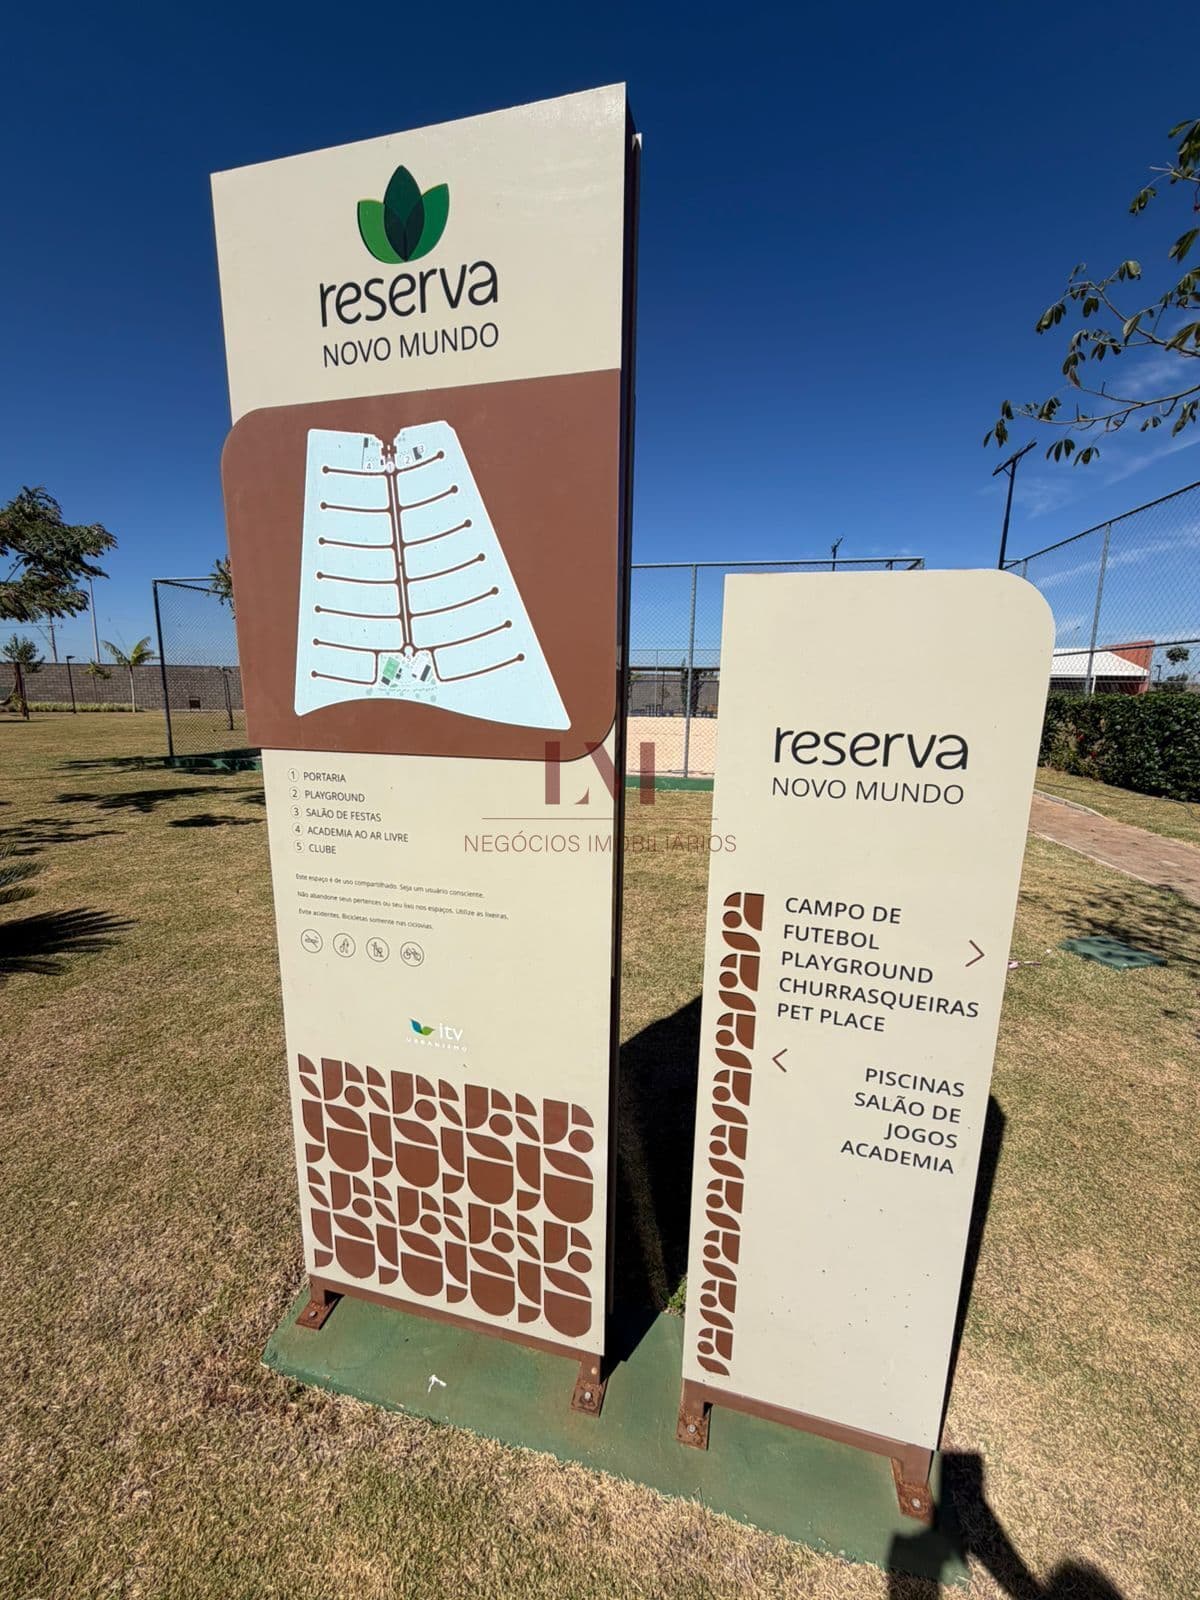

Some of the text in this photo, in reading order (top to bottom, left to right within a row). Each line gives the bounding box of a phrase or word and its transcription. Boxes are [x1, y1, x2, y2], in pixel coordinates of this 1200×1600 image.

[320, 260, 499, 327] reserva
[323, 322, 499, 368] NOVO MUNDO
[773, 726, 970, 771] reserva
[303, 771, 347, 783] PORTARIA
[771, 776, 965, 806] NOVO MUNDO
[304, 789, 365, 803] PLAYGROUND
[306, 807, 334, 819] SALÃO
[336, 810, 348, 820] DE
[350, 811, 382, 823] FESTAS
[307, 826, 353, 839] ACADEMIA
[354, 830, 368, 840] AO
[369, 831, 382, 841] AR
[384, 832, 408, 843] LIVRE
[308, 843, 337, 855] CLUBE
[399, 883, 413, 892] Seja
[784, 896, 902, 925] CAMPO DE
[783, 923, 880, 950] FUTEBOL
[780, 950, 935, 985] PLAYGROUND
[778, 976, 980, 1019] CHURRASQUEIRAS
[777, 1002, 887, 1033] PET PLACE
[865, 1067, 966, 1098] PISCINAS
[853, 1091, 962, 1125] SALÃO DE
[883, 1121, 959, 1150] JOGOS
[840, 1139, 955, 1175] ACADEMIA
